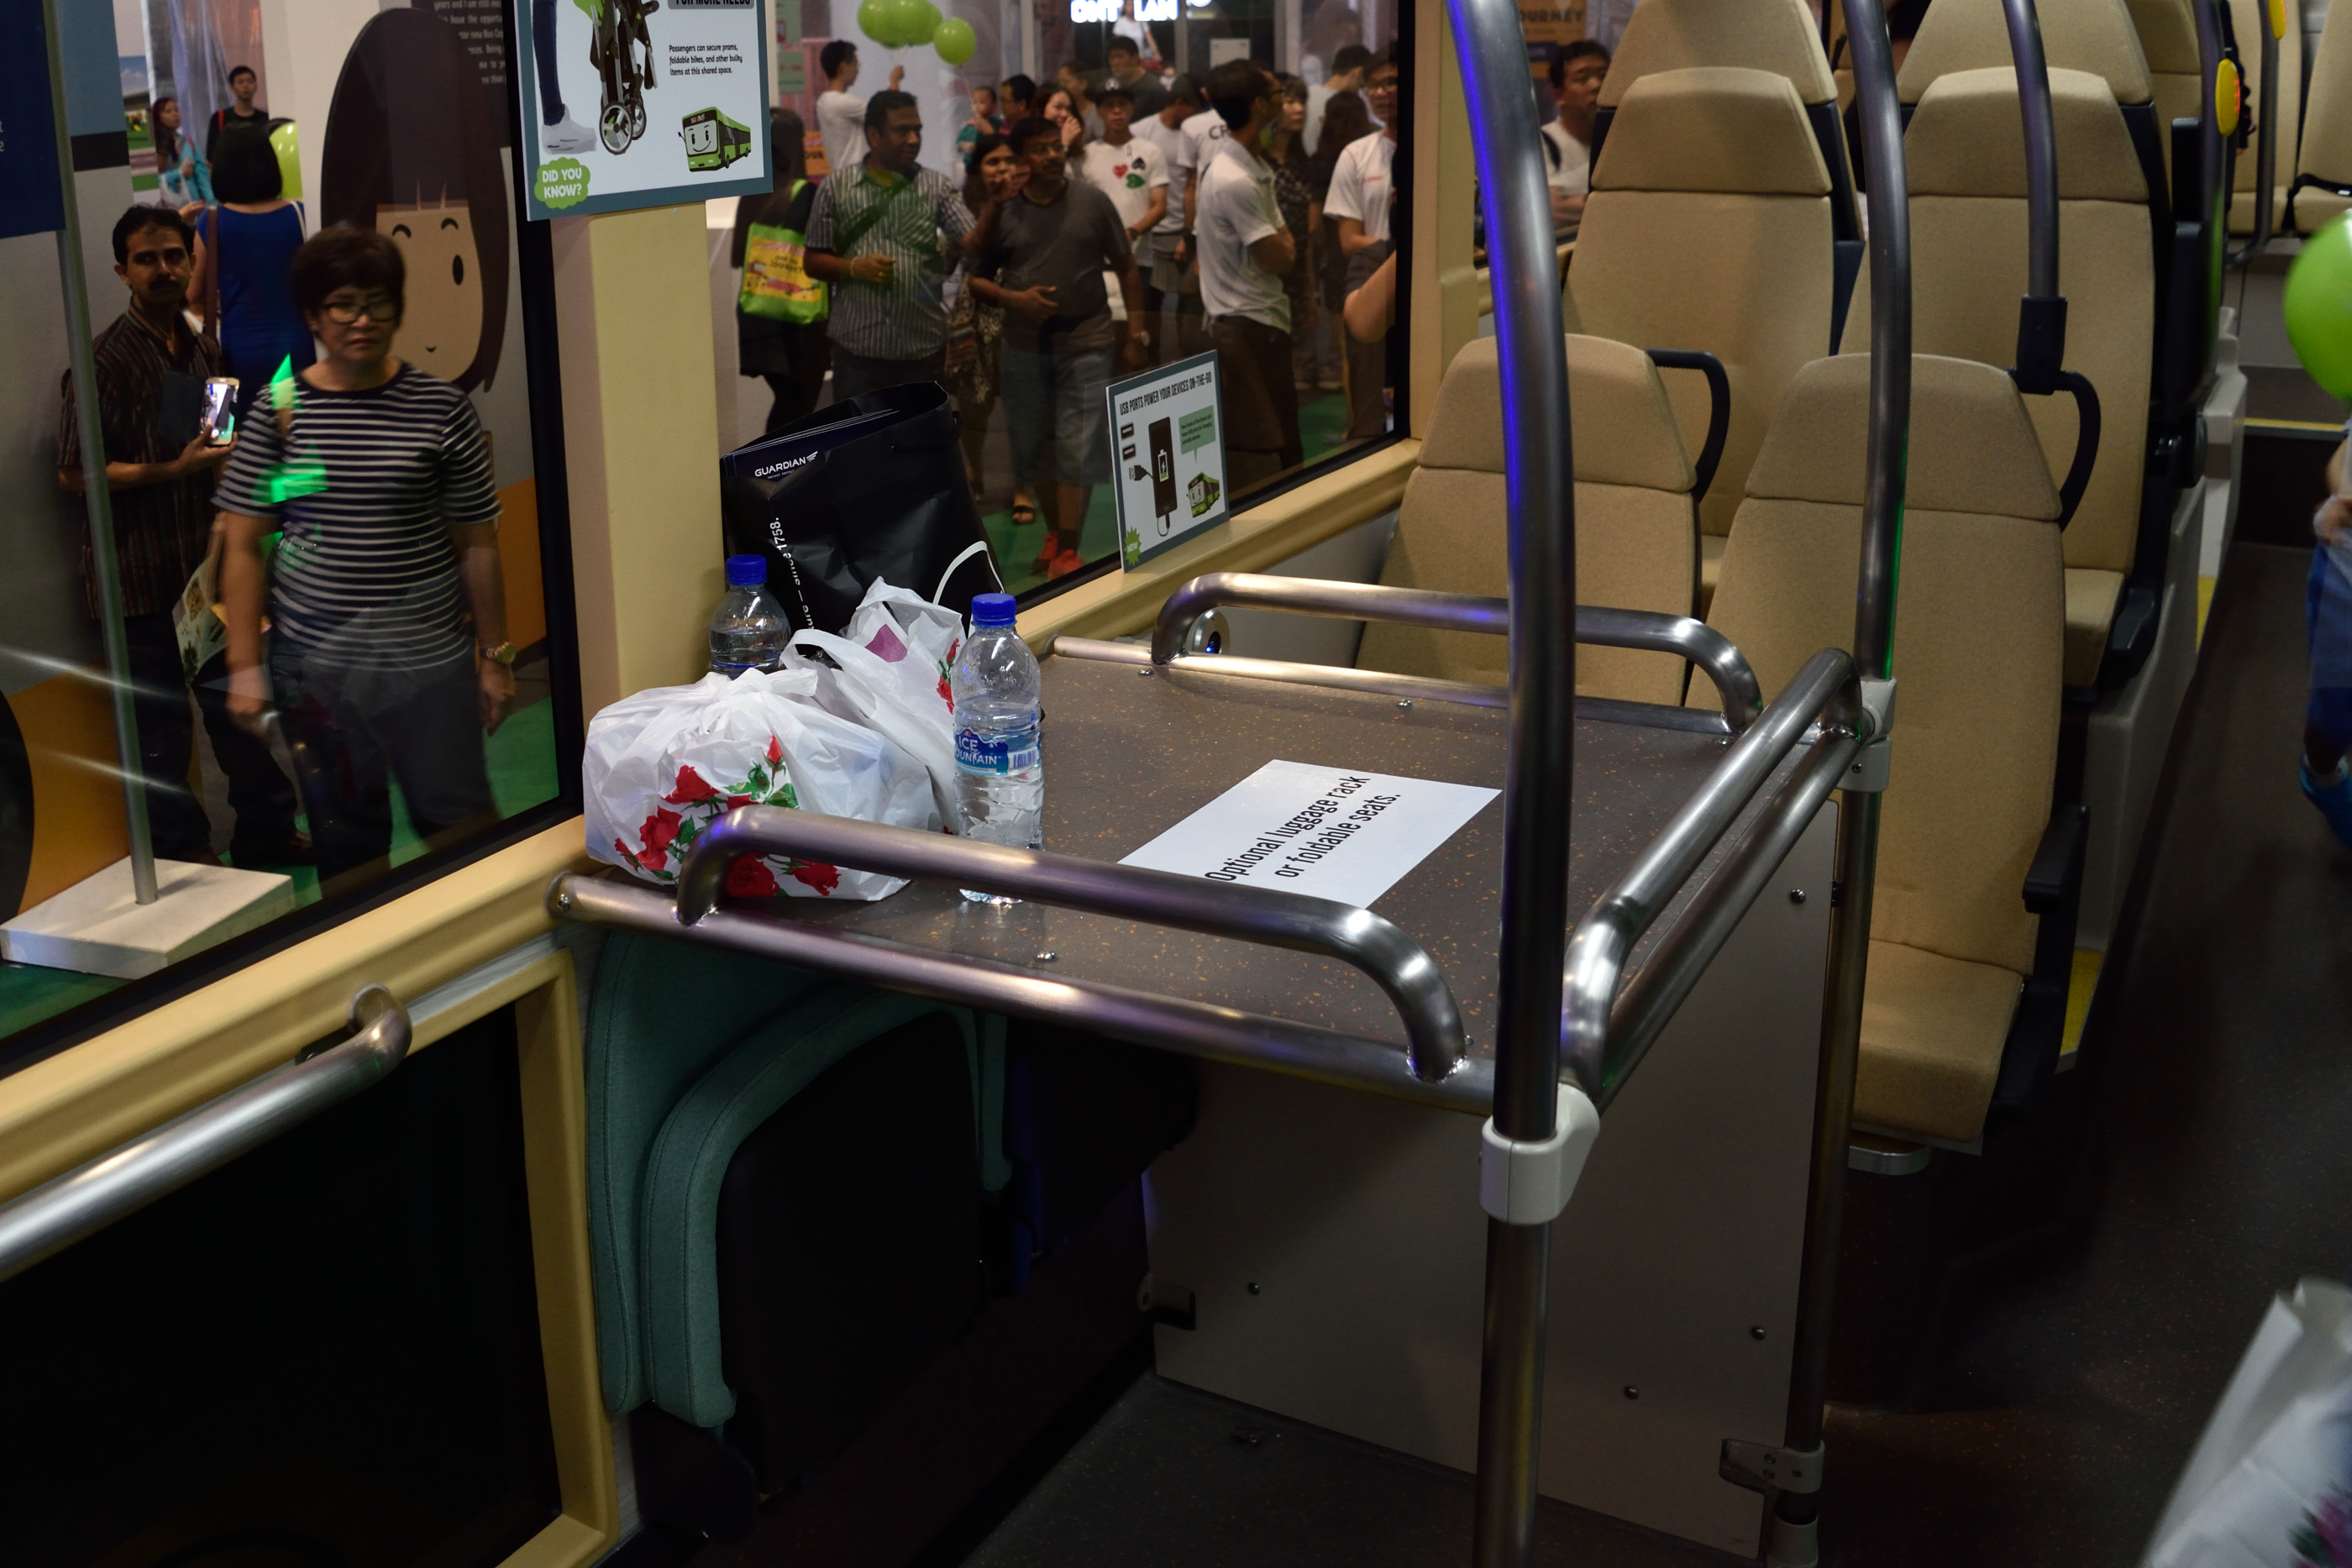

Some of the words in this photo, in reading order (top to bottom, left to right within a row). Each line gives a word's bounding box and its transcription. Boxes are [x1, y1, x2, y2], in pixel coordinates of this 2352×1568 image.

[669, 45, 696, 54] Passengers
[669, 55, 690, 66] foldable
[690, 55, 705, 64] bikes,
[729, 54, 743, 63] bulky
[669, 67, 684, 76] items
[701, 66, 717, 75] shared
[718, 67, 732, 76] space.
[542, 170, 559, 183] DID
[561, 167, 582, 181] YOU
[543, 183, 582, 199] KNOW?
[1119, 402, 1130, 416] USB
[1129, 396, 1144, 412] PORTS
[1143, 391, 1159, 406] POWER
[1158, 385, 1172, 401] YOUR
[1171, 380, 1189, 396] DEVICES
[1189, 371, 1212, 390] ON-THE-GO
[754, 456, 806, 477] GUARDIAN
[769, 517, 788, 551] 1758.
[1126, 542, 1138, 553] NEW
[958, 736, 979, 753] ICE
[1348, 794, 1401, 821] seats.
[1205, 837, 1286, 881] Optional
[1264, 800, 1339, 838] luggage
[1326, 776, 1371, 800] rack
[1286, 821, 1362, 864] foldable
[1274, 864, 1305, 878] or
